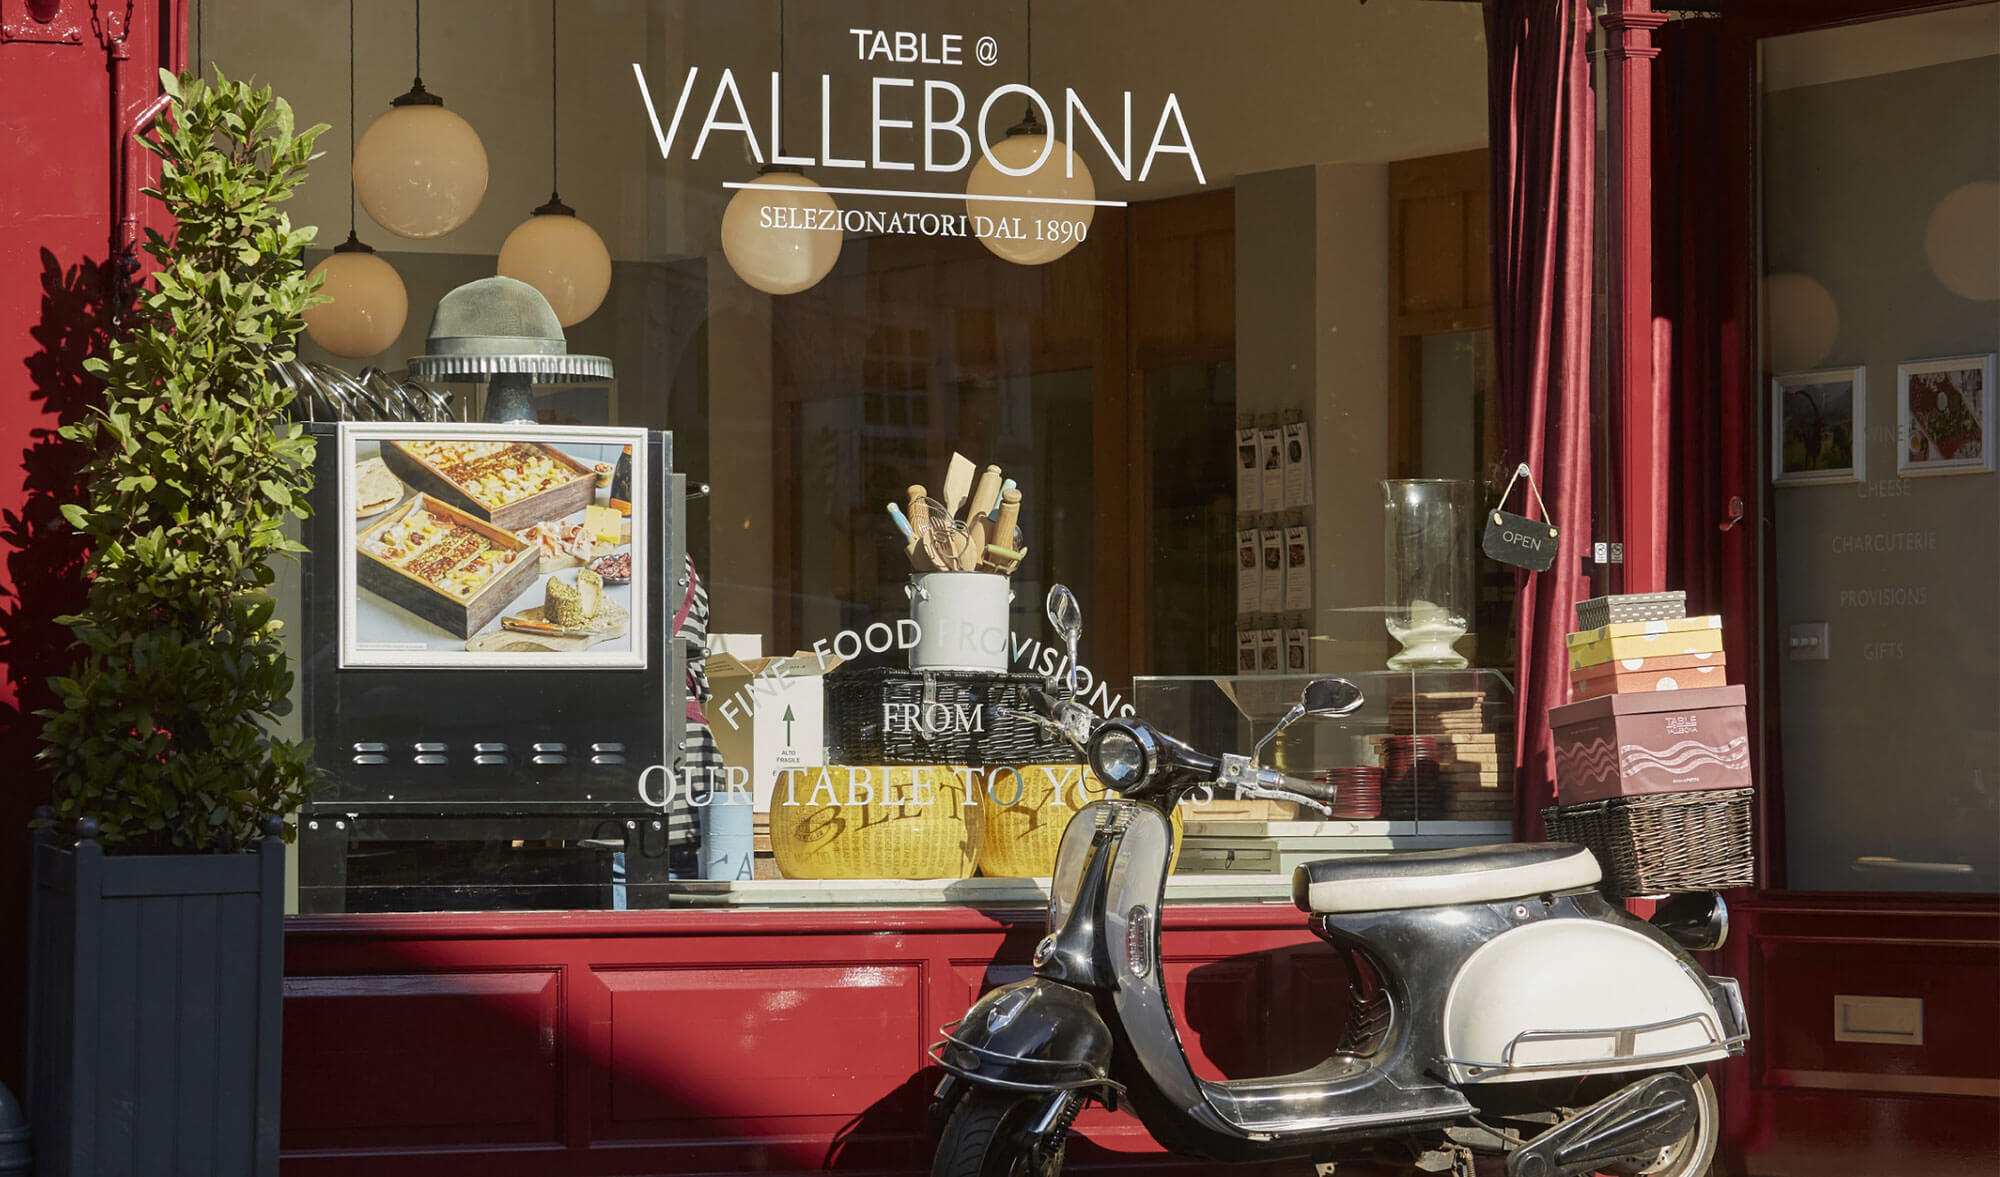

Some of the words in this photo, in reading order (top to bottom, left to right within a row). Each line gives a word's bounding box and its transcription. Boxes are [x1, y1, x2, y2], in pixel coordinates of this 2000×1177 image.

[850, 29, 963, 65] TABLE
[975, 36, 998, 67] @
[632, 63, 1207, 185] VALLEBONA
[759, 205, 967, 238] SELEZIONATORI
[974, 214, 1027, 241] DAL
[1034, 217, 1088, 245] 1890
[1857, 479, 1912, 498] CHEESE
[1502, 530, 1542, 551] OPEN
[1832, 531, 1937, 553] CHARCUTERIE
[1840, 586, 1928, 607] PROVISIONS
[1863, 640, 1905, 661] GIFTS
[719, 659, 796, 731] FINE
[812, 619, 922, 671] FOOD
[882, 702, 985, 733] FROM
[1664, 715, 1697, 727] TABLE
[637, 764, 757, 807] OUR
[778, 764, 935, 807] TABLE
[953, 765, 1024, 807] TO
